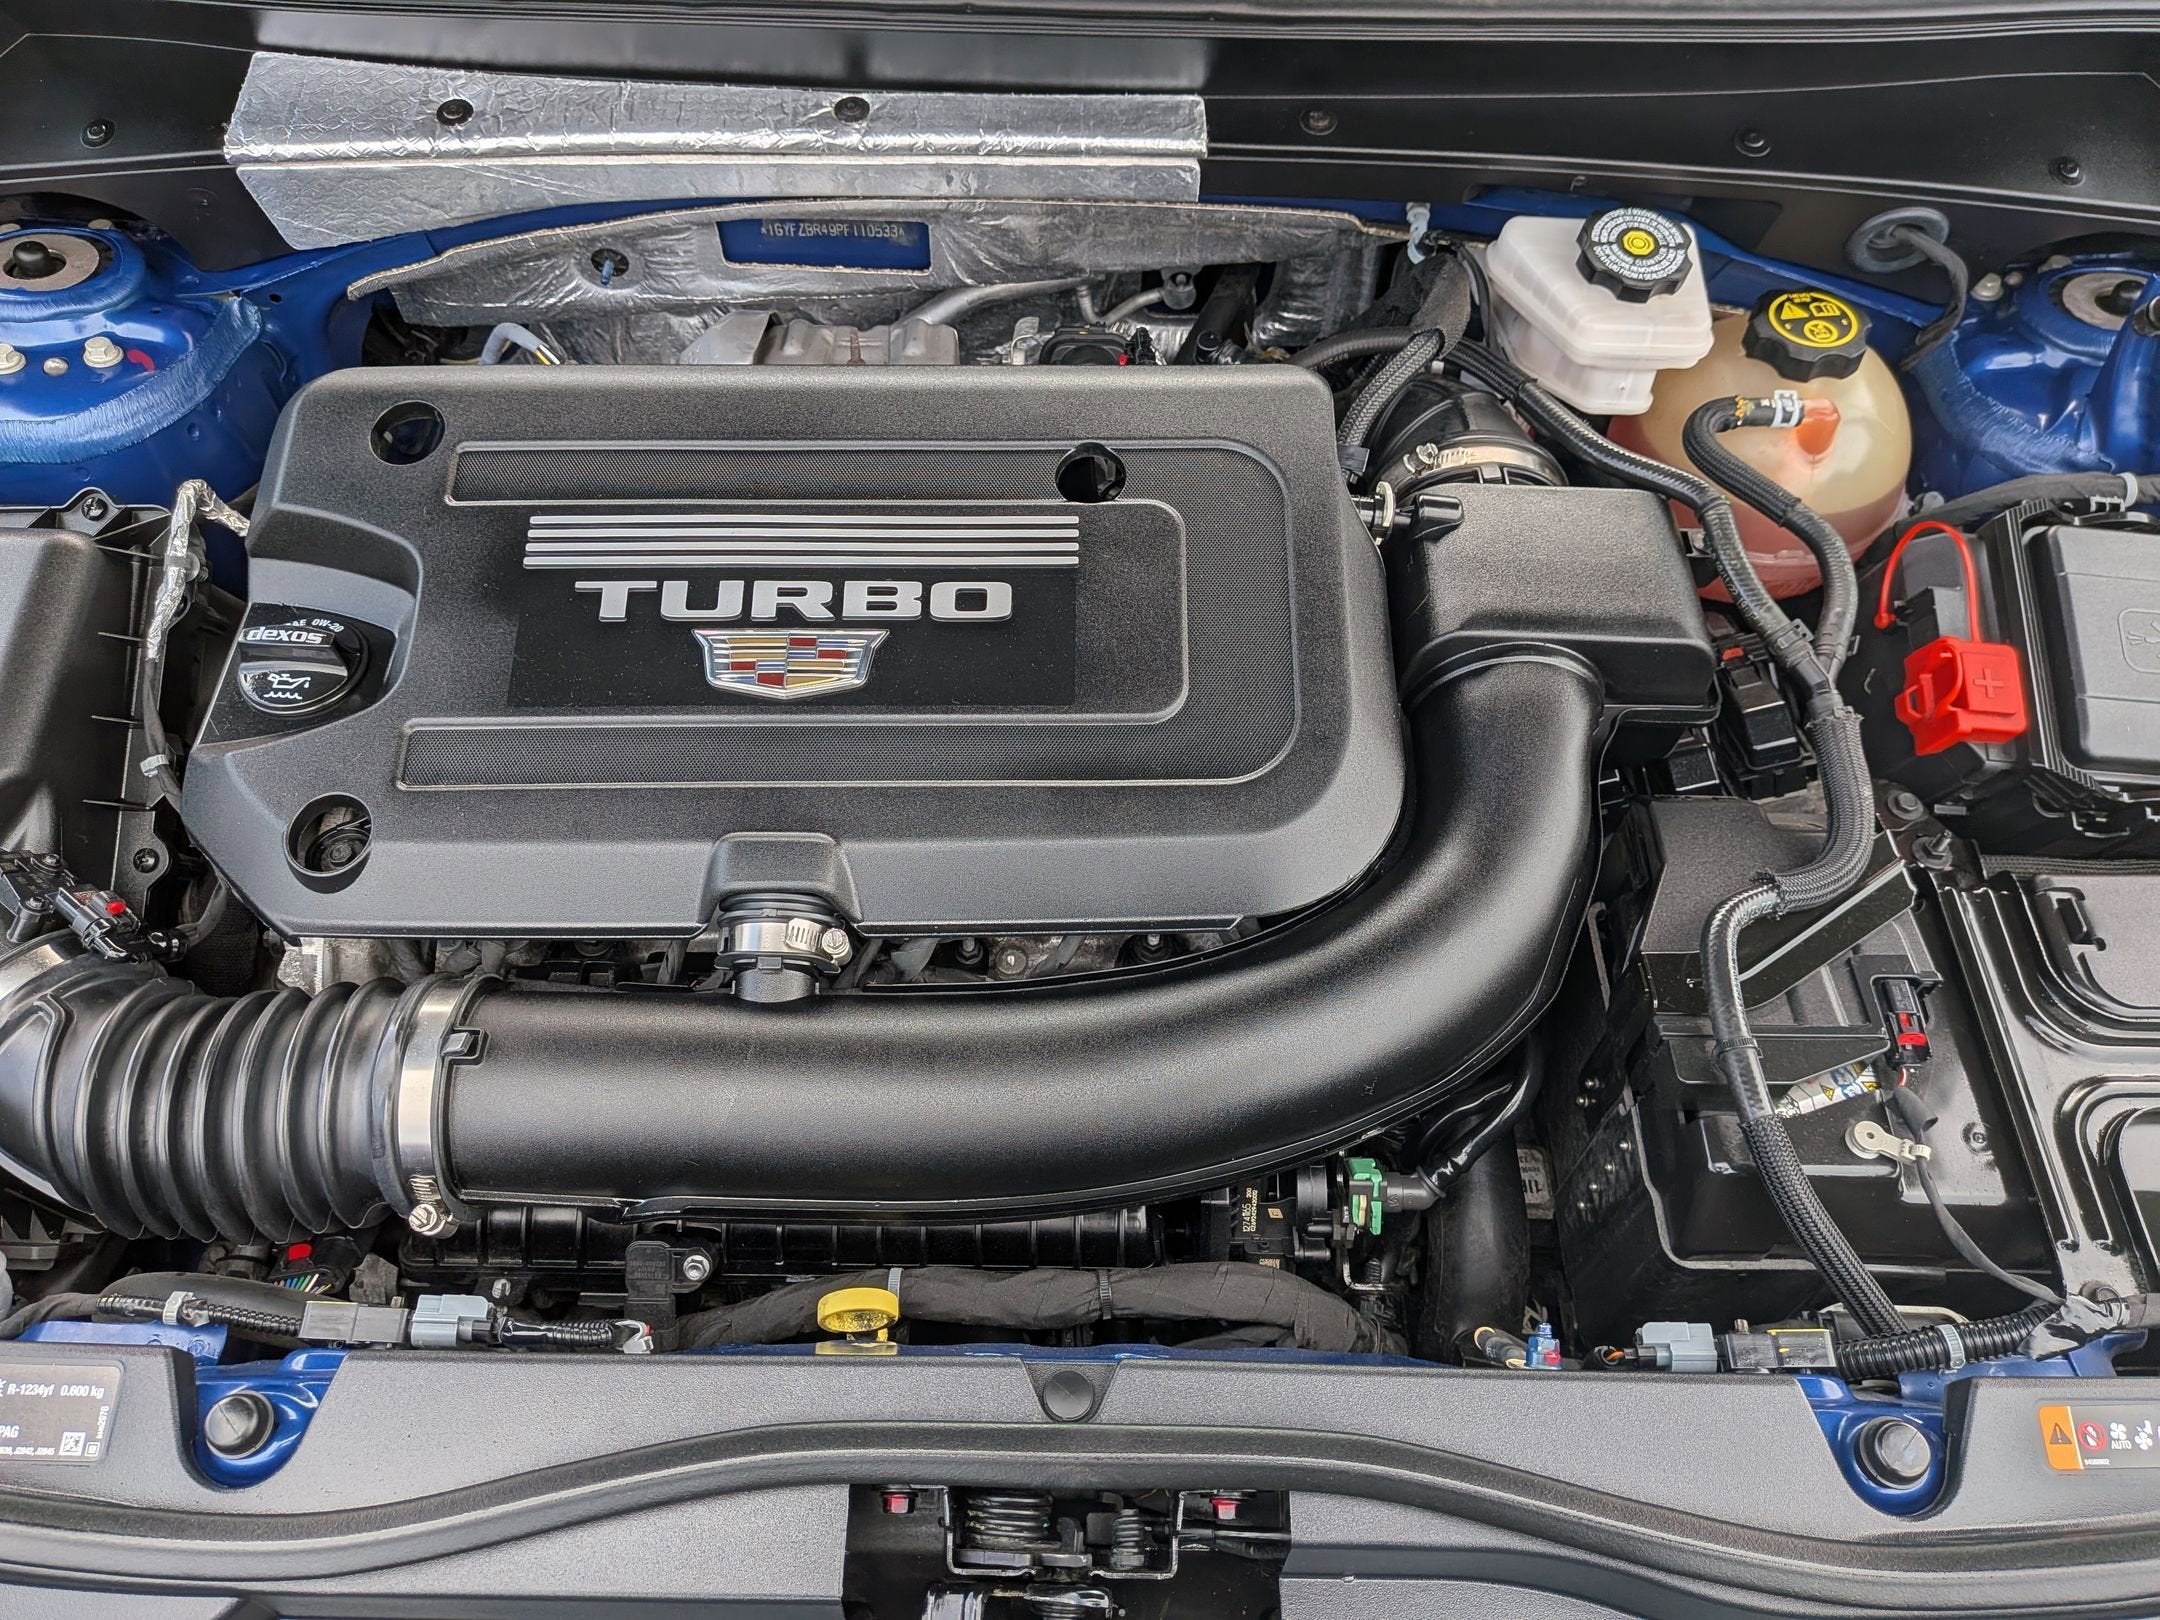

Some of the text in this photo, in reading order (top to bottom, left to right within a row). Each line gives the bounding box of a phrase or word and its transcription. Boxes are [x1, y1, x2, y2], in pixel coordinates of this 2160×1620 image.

[575, 580, 1012, 622] TURBO
[311, 618, 345, 633] 0W-20
[246, 627, 327, 645] dexos
[7, 1383, 105, 1399] R-1234yf 0.600 kg
[2111, 1440, 2132, 1450] AUTO
